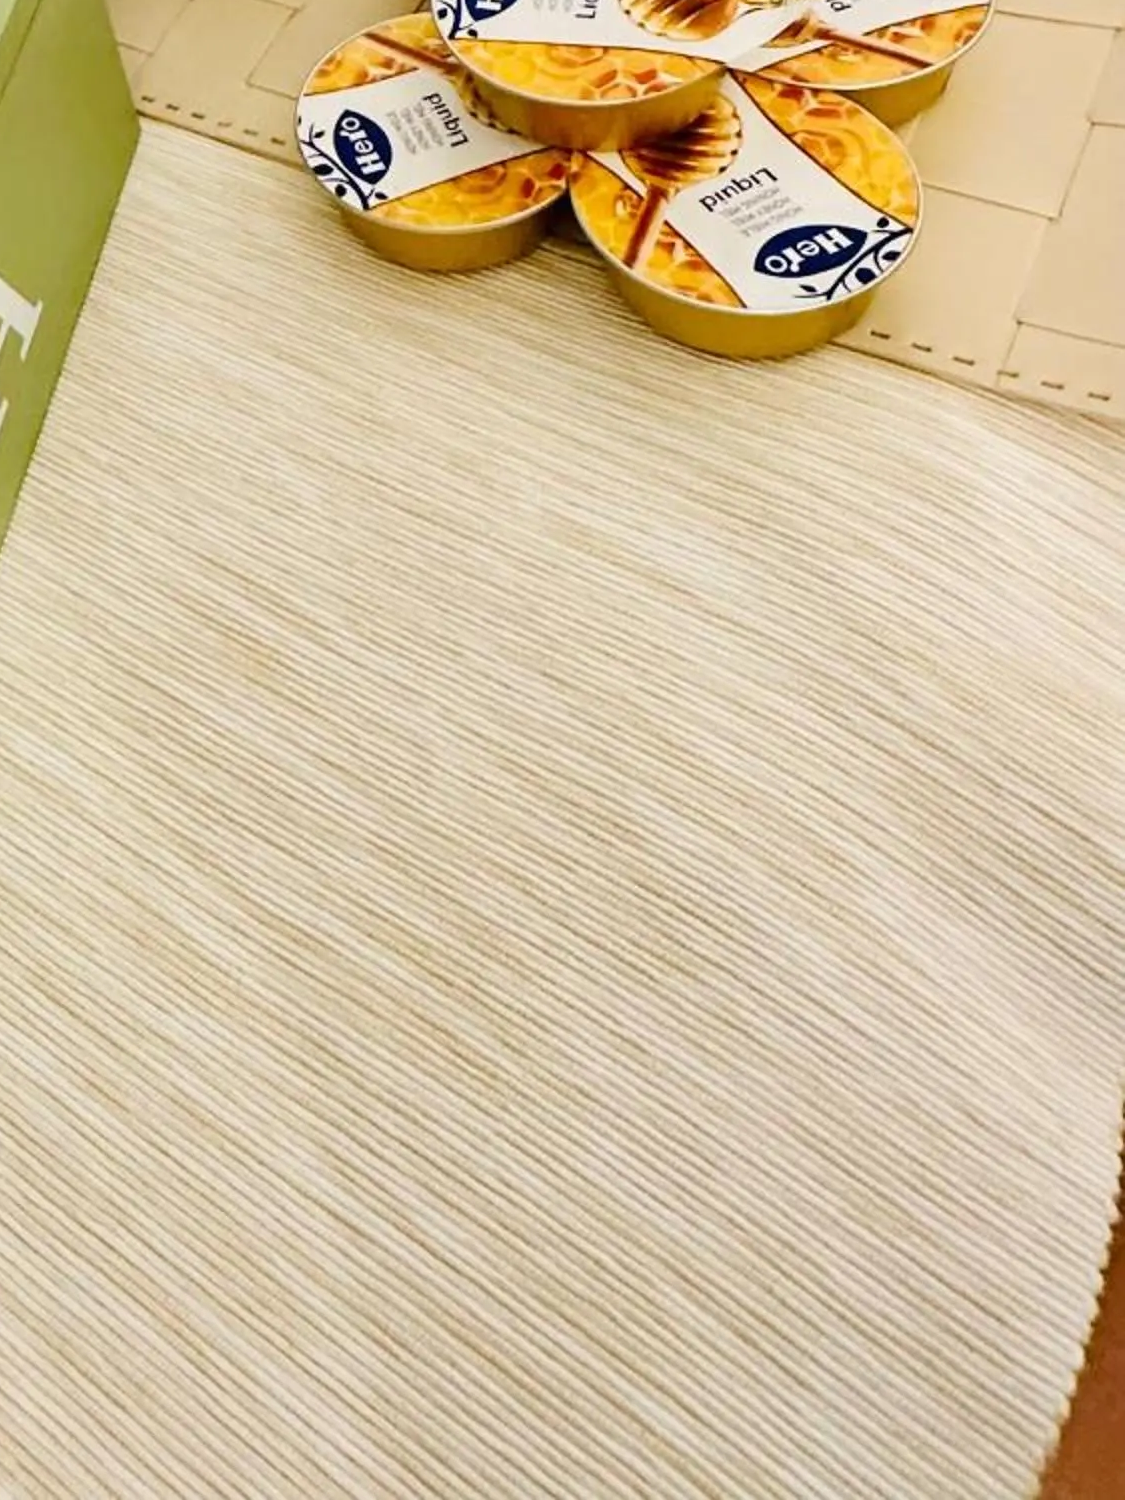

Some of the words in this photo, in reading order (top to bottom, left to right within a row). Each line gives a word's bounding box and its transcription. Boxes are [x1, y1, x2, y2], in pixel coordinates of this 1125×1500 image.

[339, 116, 387, 175] Hero
[423, 92, 469, 148] Liquid
[698, 167, 778, 213] Liquid
[764, 227, 855, 273] Hero
